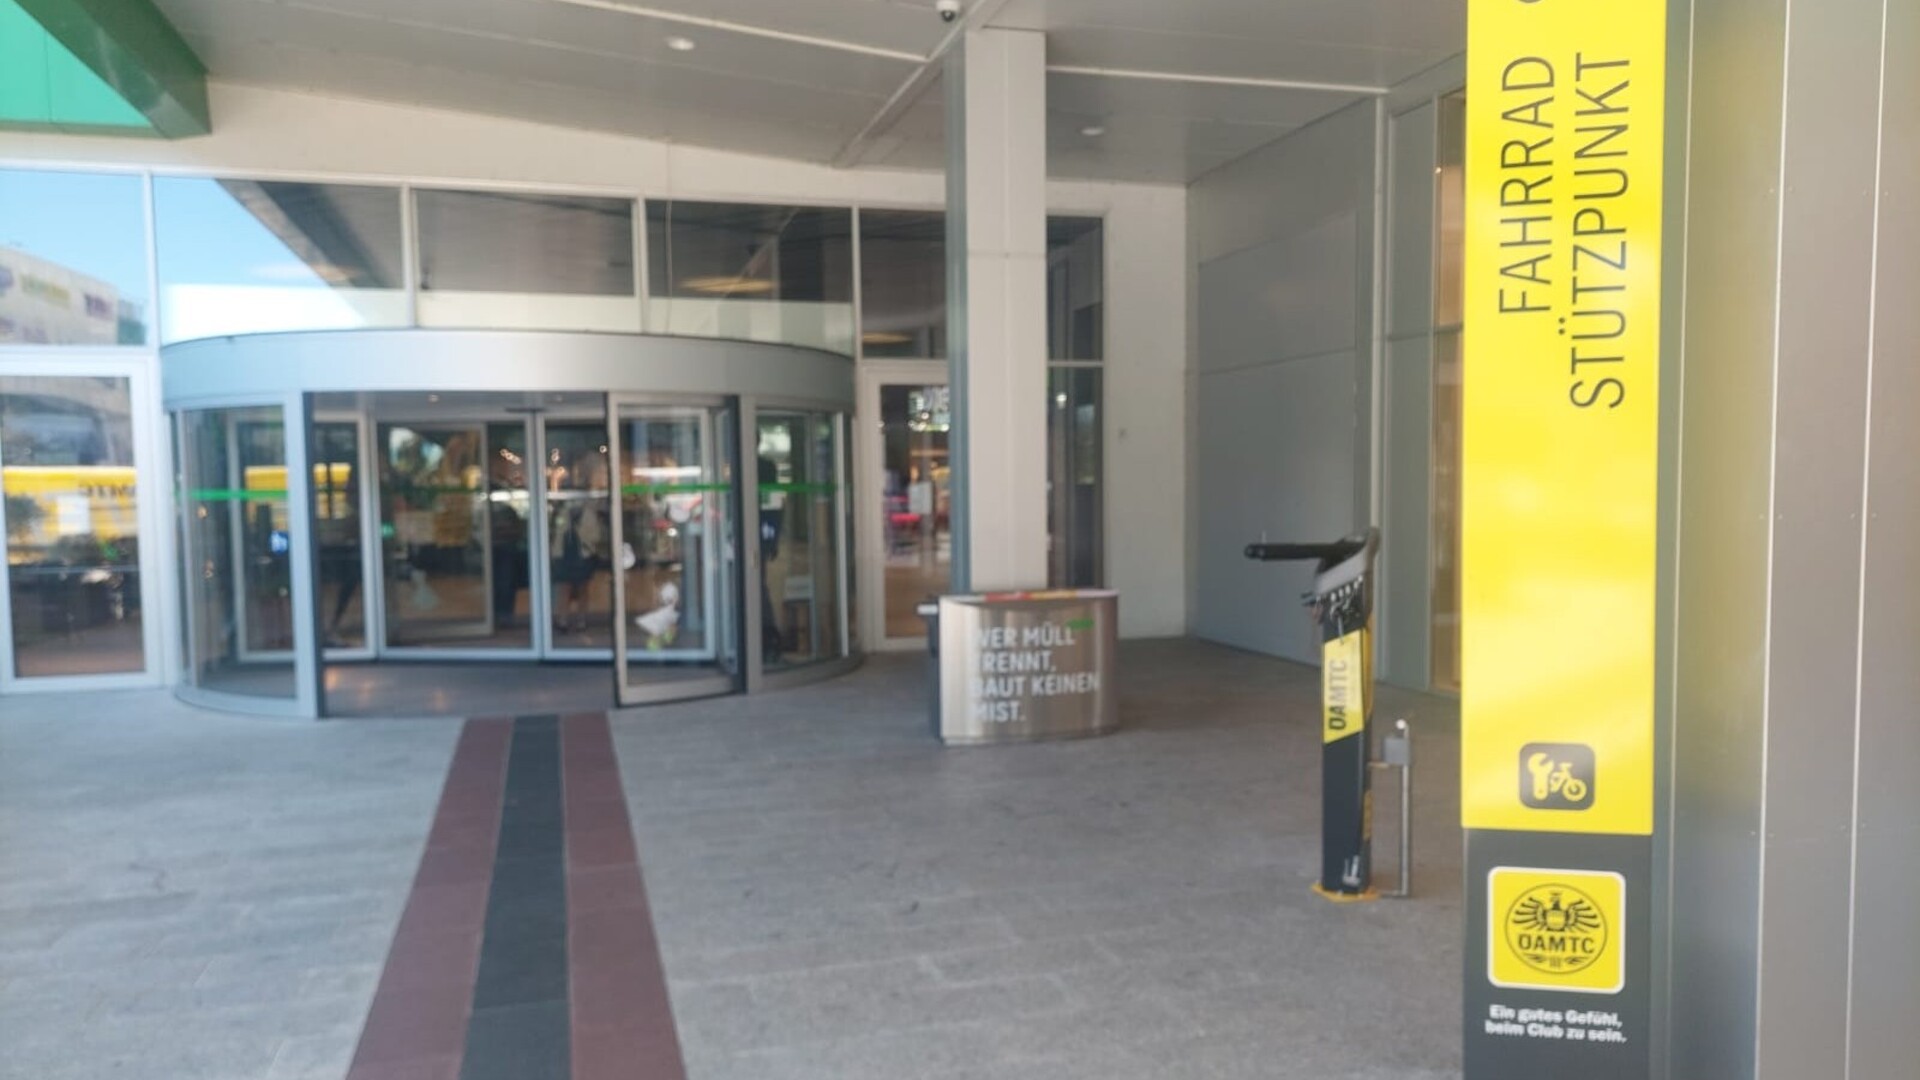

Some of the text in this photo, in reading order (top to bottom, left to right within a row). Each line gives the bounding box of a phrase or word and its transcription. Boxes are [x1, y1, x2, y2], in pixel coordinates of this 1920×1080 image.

[1498, 56, 1555, 313] FAHRRAD
[1558, 52, 1630, 408] STÜTZPUNKT
[1022, 620, 1076, 648] MÜLL
[1489, 1004, 1623, 1028] Ein gutes Gefühl,
[1485, 1019, 1628, 1043] beim Club zu sein.
